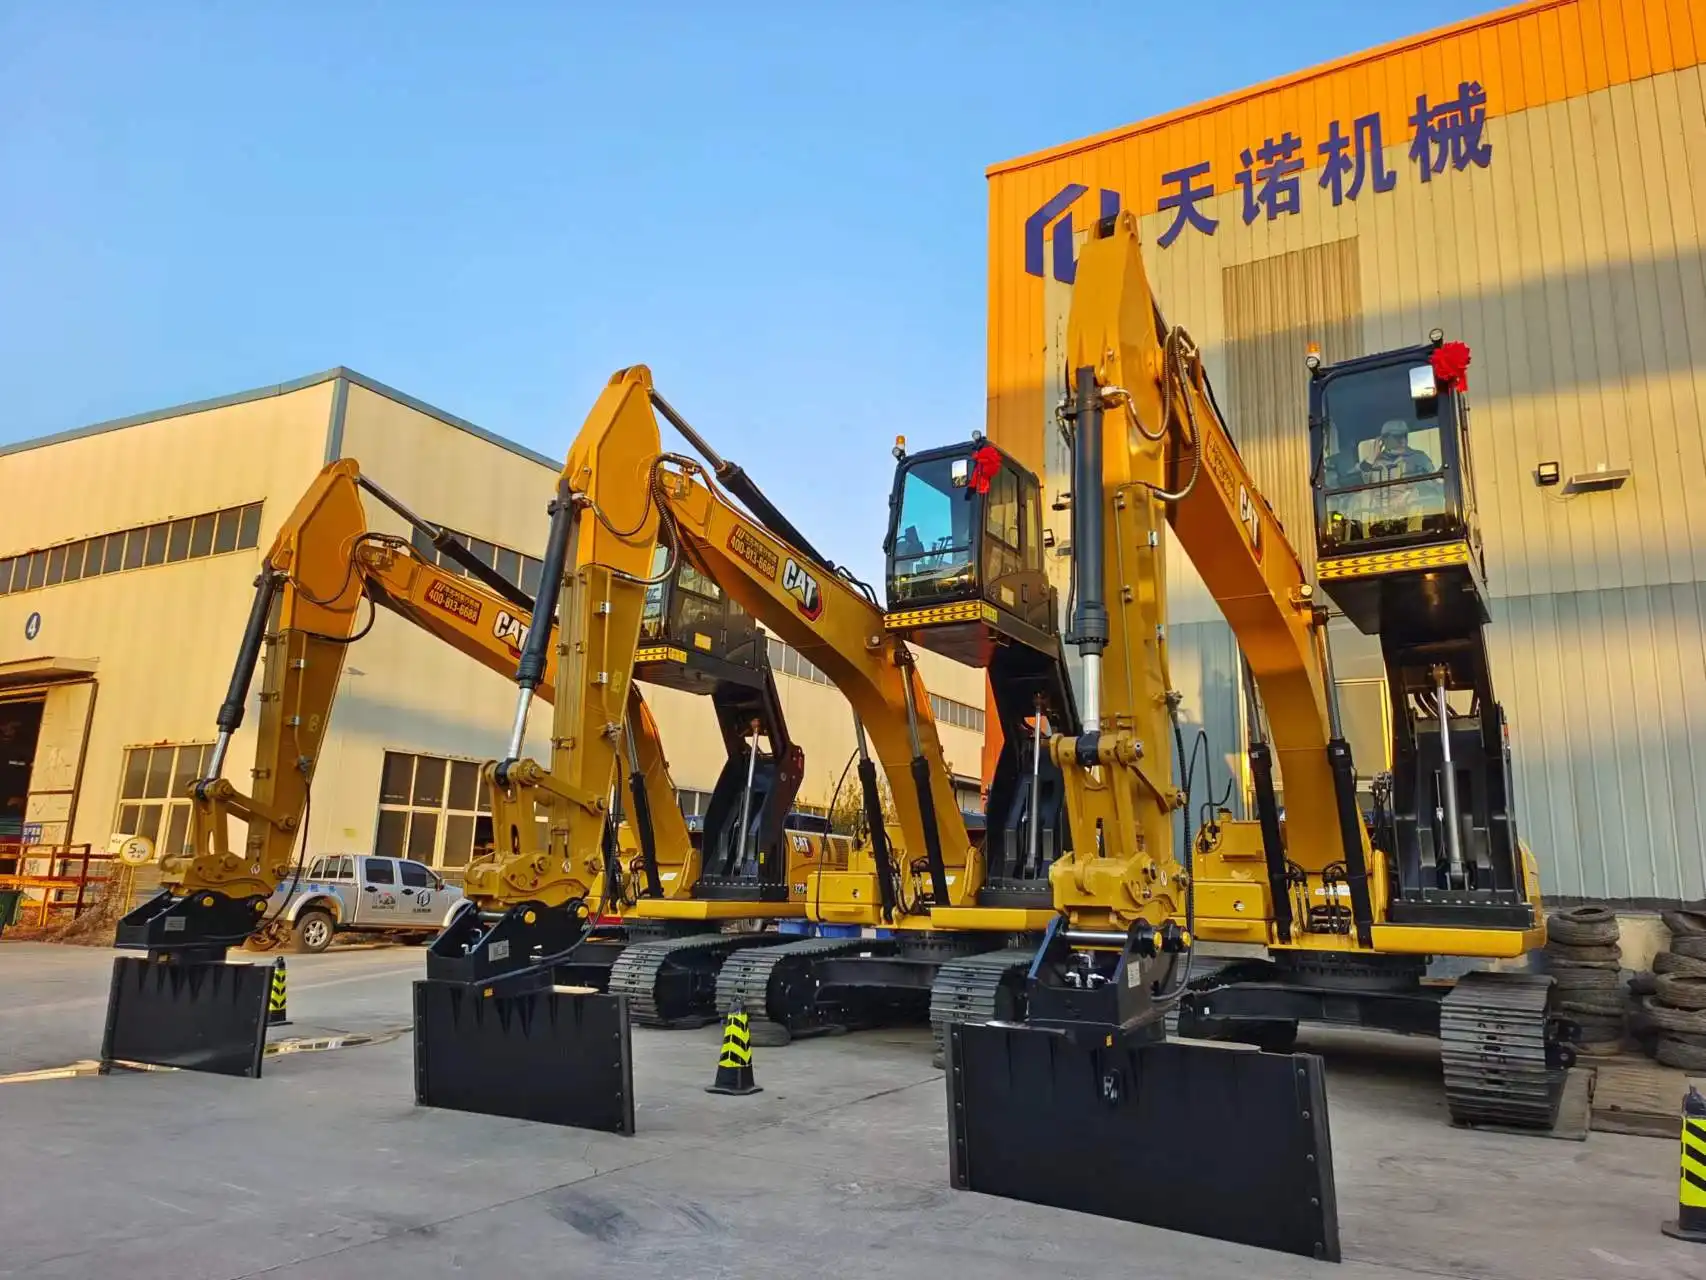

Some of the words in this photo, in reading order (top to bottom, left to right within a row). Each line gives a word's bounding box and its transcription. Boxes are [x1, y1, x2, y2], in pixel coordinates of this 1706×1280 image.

[1156, 81, 1493, 249] 天诺机械
[1240, 484, 1259, 548] CAT
[783, 558, 817, 608] CAT
[429, 589, 477, 622] 400-813-6688
[27, 615, 38, 637] 4
[494, 611, 530, 651] CAT
[793, 836, 809, 853] CAT
